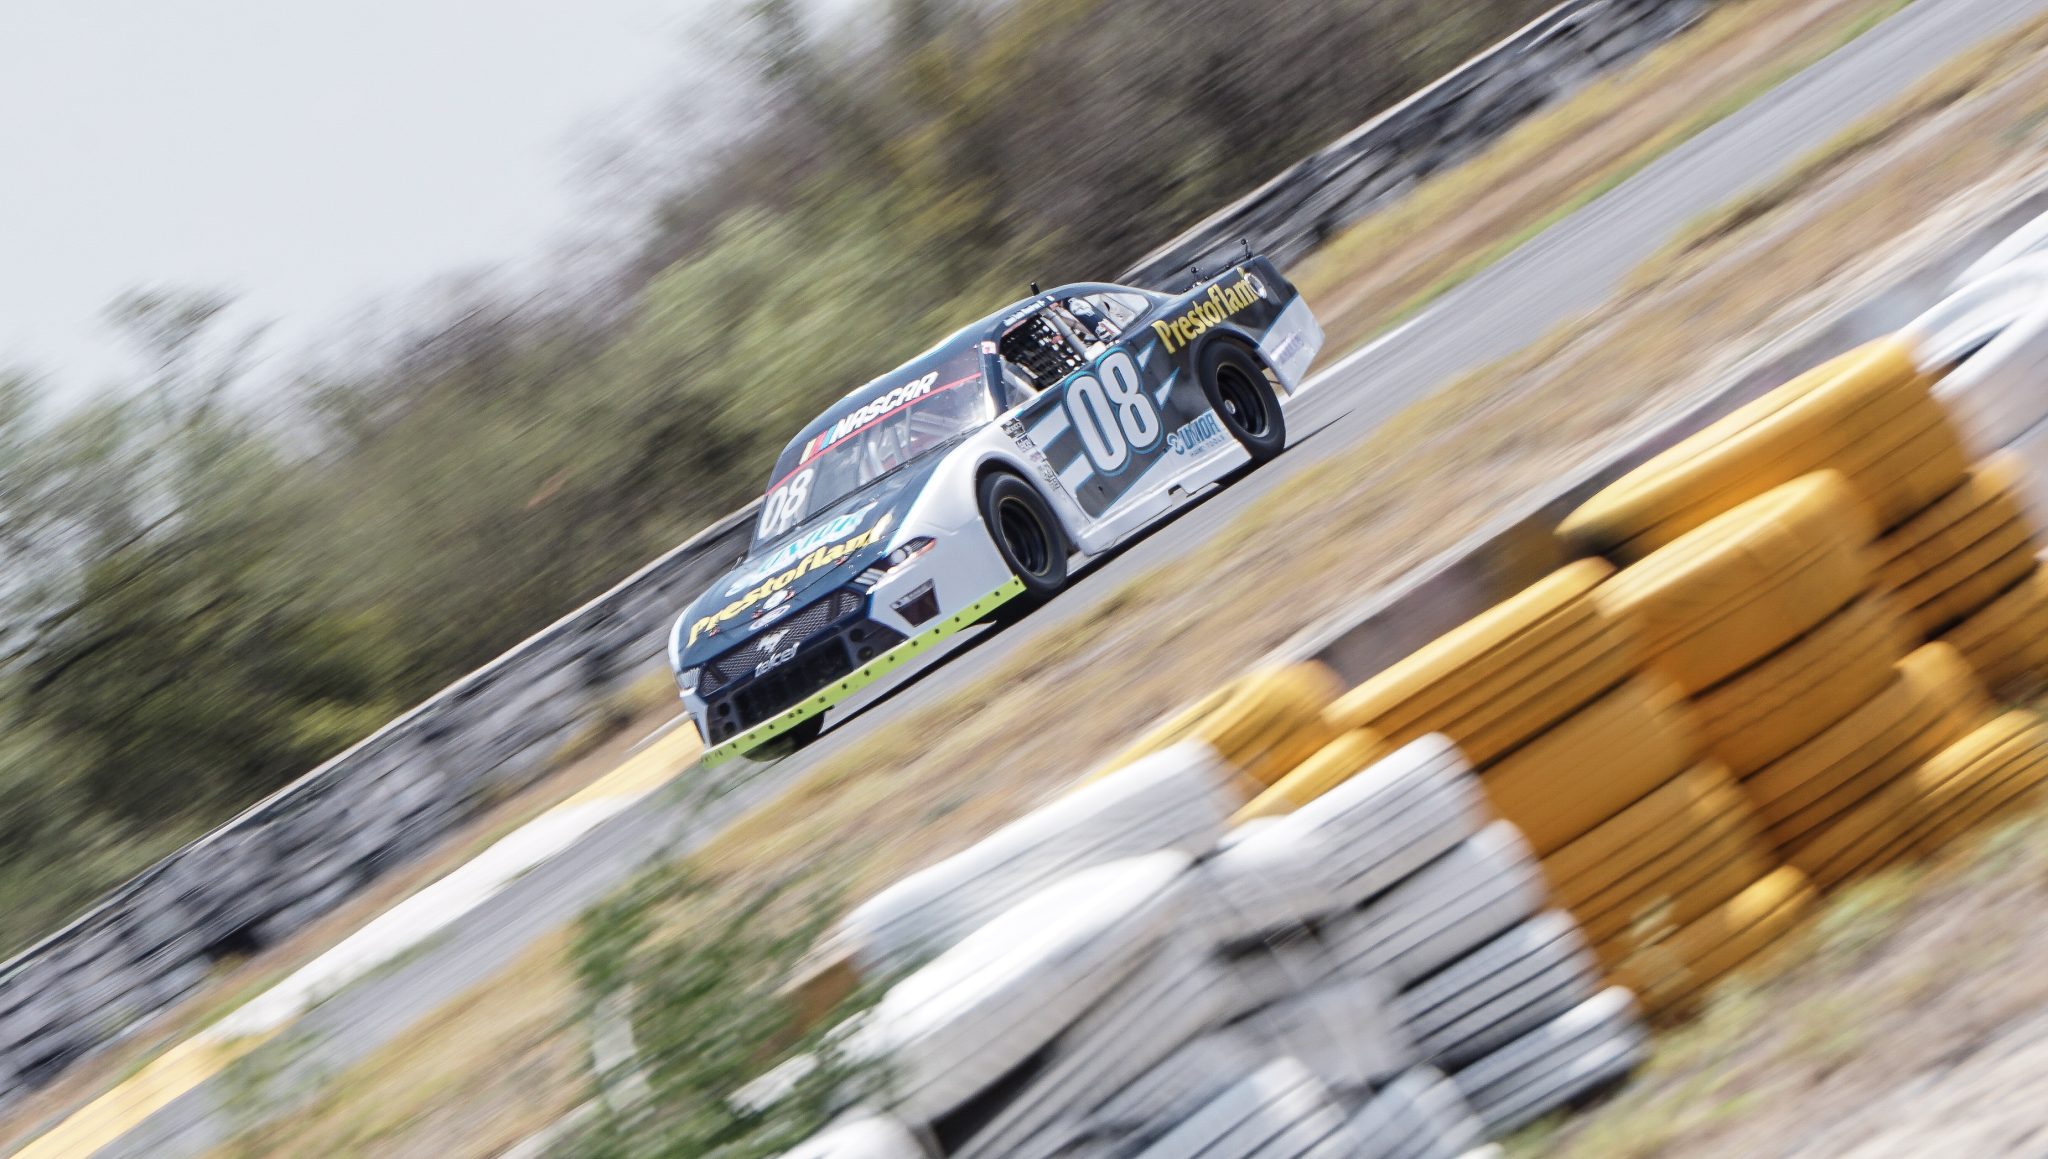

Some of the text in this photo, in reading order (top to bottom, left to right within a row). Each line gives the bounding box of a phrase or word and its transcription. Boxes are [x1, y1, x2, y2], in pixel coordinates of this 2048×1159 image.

[829, 371, 939, 444] NASCAR
[1065, 350, 1161, 473] 08
[758, 468, 815, 540] 08
